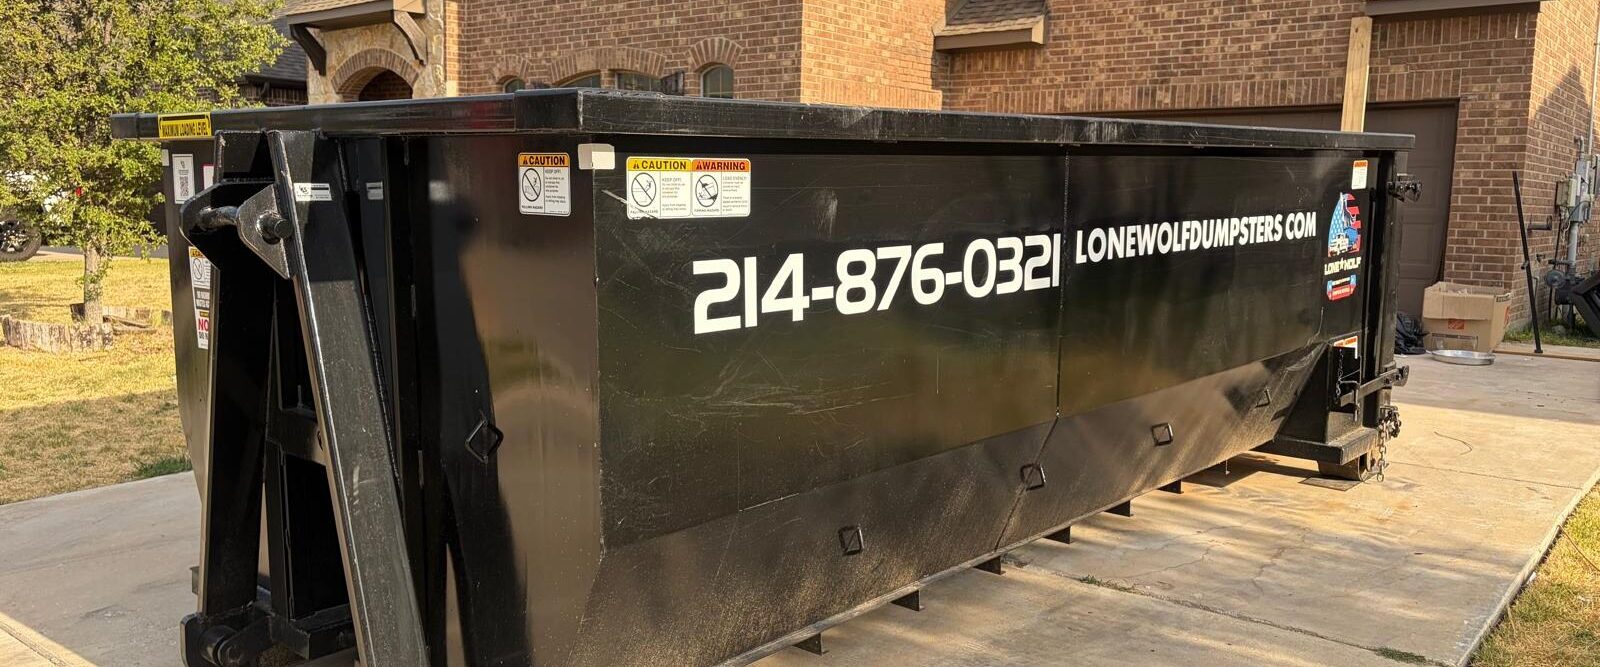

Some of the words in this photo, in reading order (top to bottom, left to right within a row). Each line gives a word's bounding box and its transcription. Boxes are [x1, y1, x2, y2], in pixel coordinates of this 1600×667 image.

[180, 122, 196, 136] LOADING
[196, 121, 208, 136] LEVEL
[528, 155, 566, 166] CAUTION
[641, 160, 687, 170] CAUTION
[702, 161, 746, 171] WARNING
[1075, 213, 1283, 265] LONEWOLFDUMPSTERS
[1285, 211, 1317, 240] COM
[1324, 261, 1341, 276] LONE
[1343, 256, 1362, 271] WOLF
[693, 233, 1061, 335] 214-876-0321
